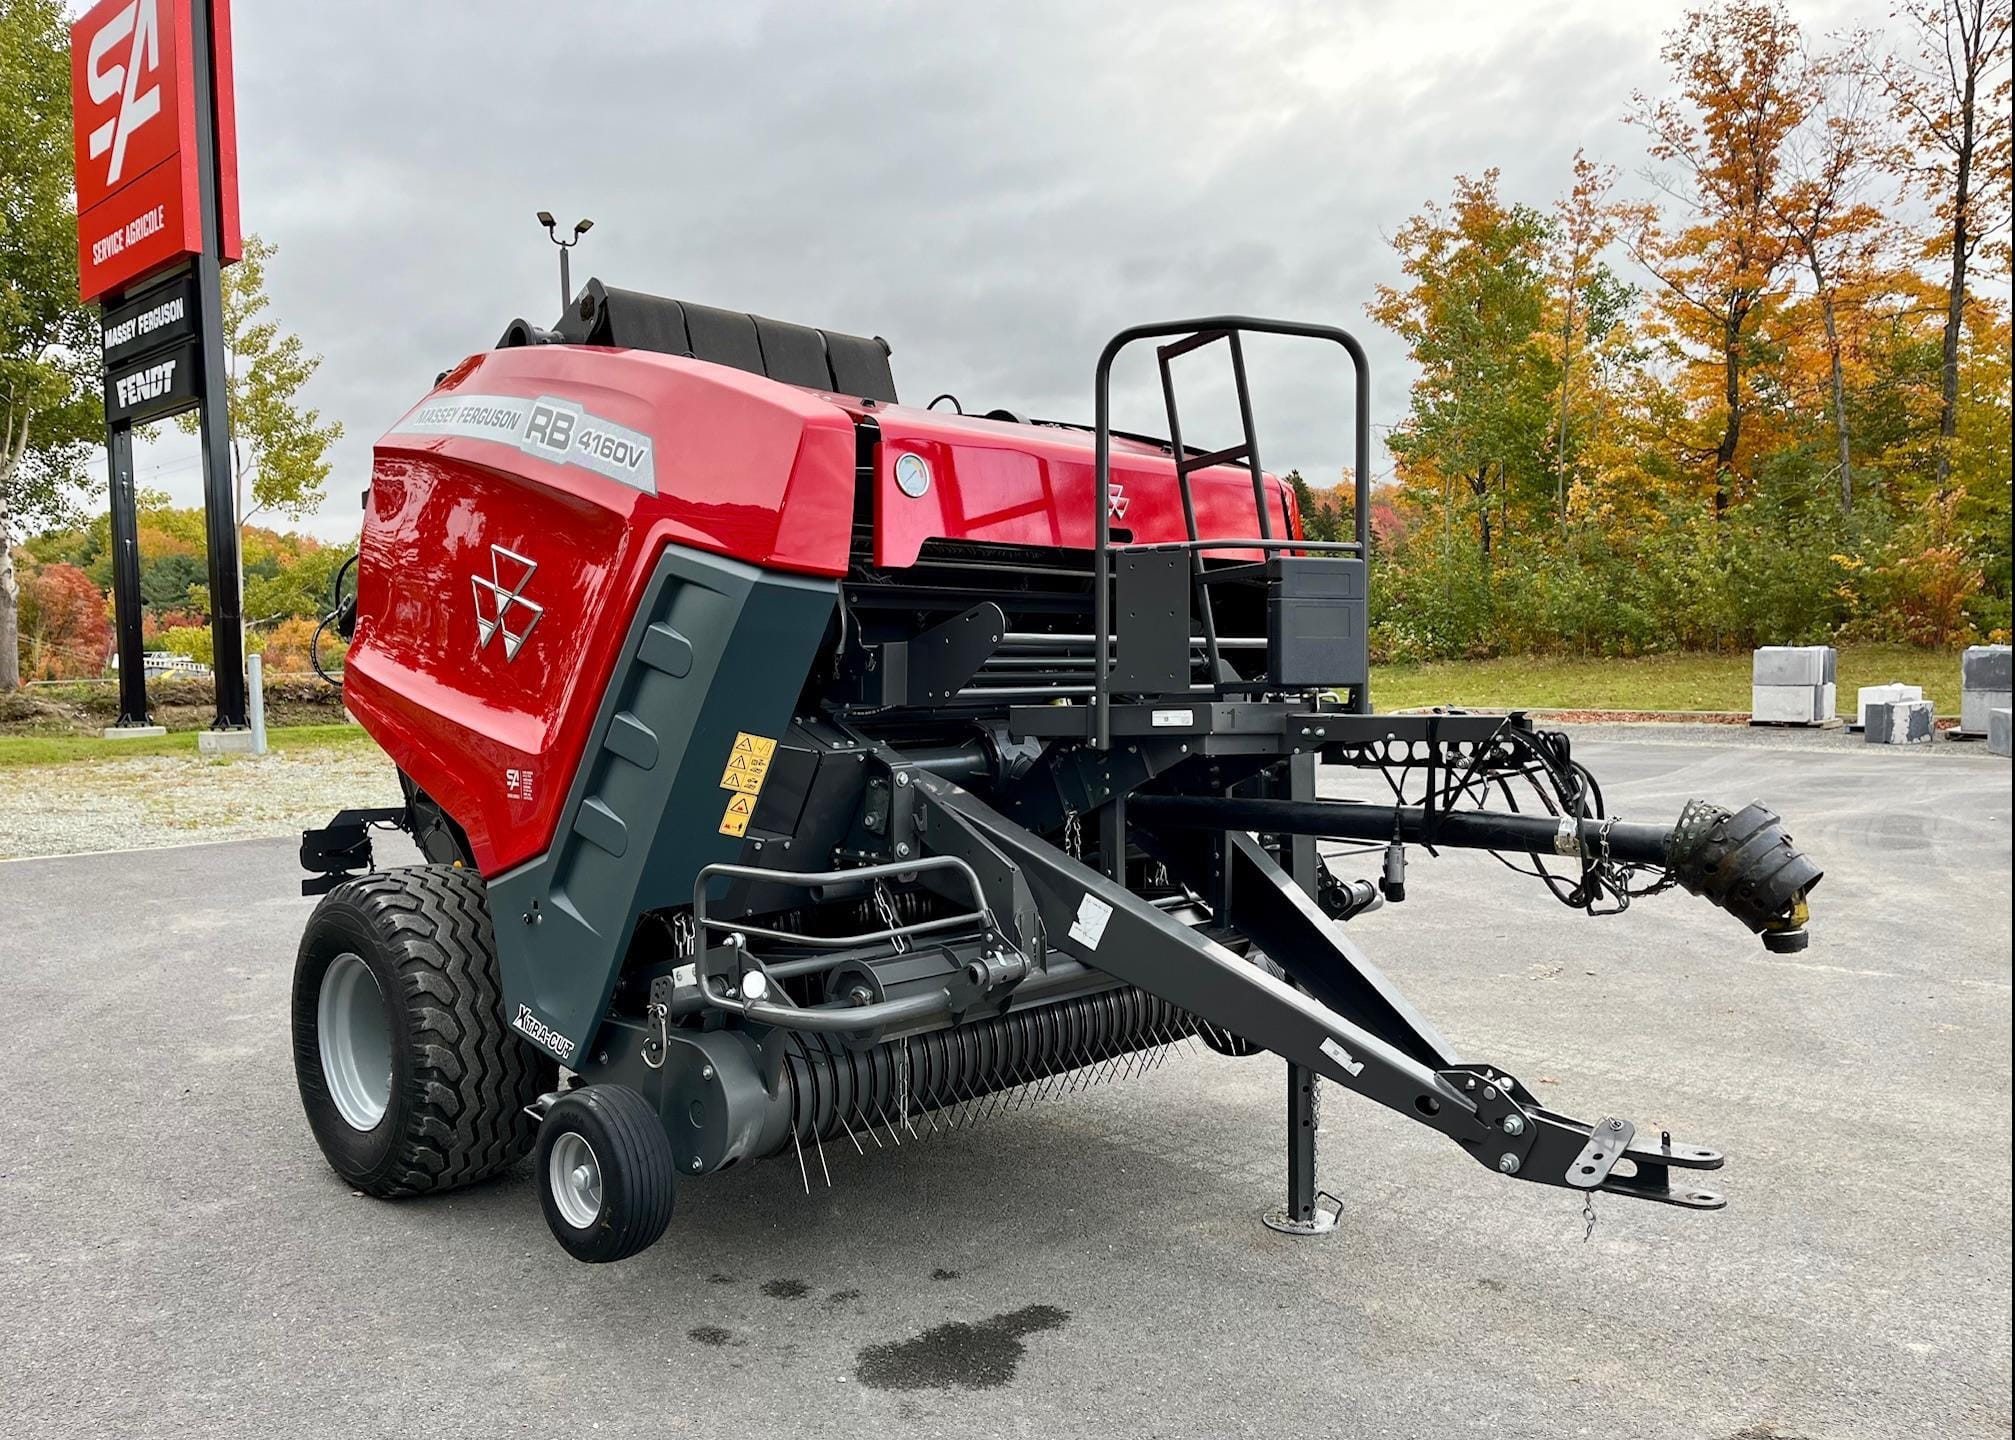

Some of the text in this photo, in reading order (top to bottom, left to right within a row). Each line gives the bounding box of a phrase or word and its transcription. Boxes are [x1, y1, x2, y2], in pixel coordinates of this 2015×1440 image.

[92, 204, 165, 266] SERVICE AGRICOLE
[104, 297, 184, 350] MASSEY FERGUSON
[116, 359, 176, 409] FENDT
[416, 406, 522, 430] MASSEY FERGUSON
[525, 404, 645, 469] RB 4160V
[512, 1003, 575, 1060] XTRA-CUT
